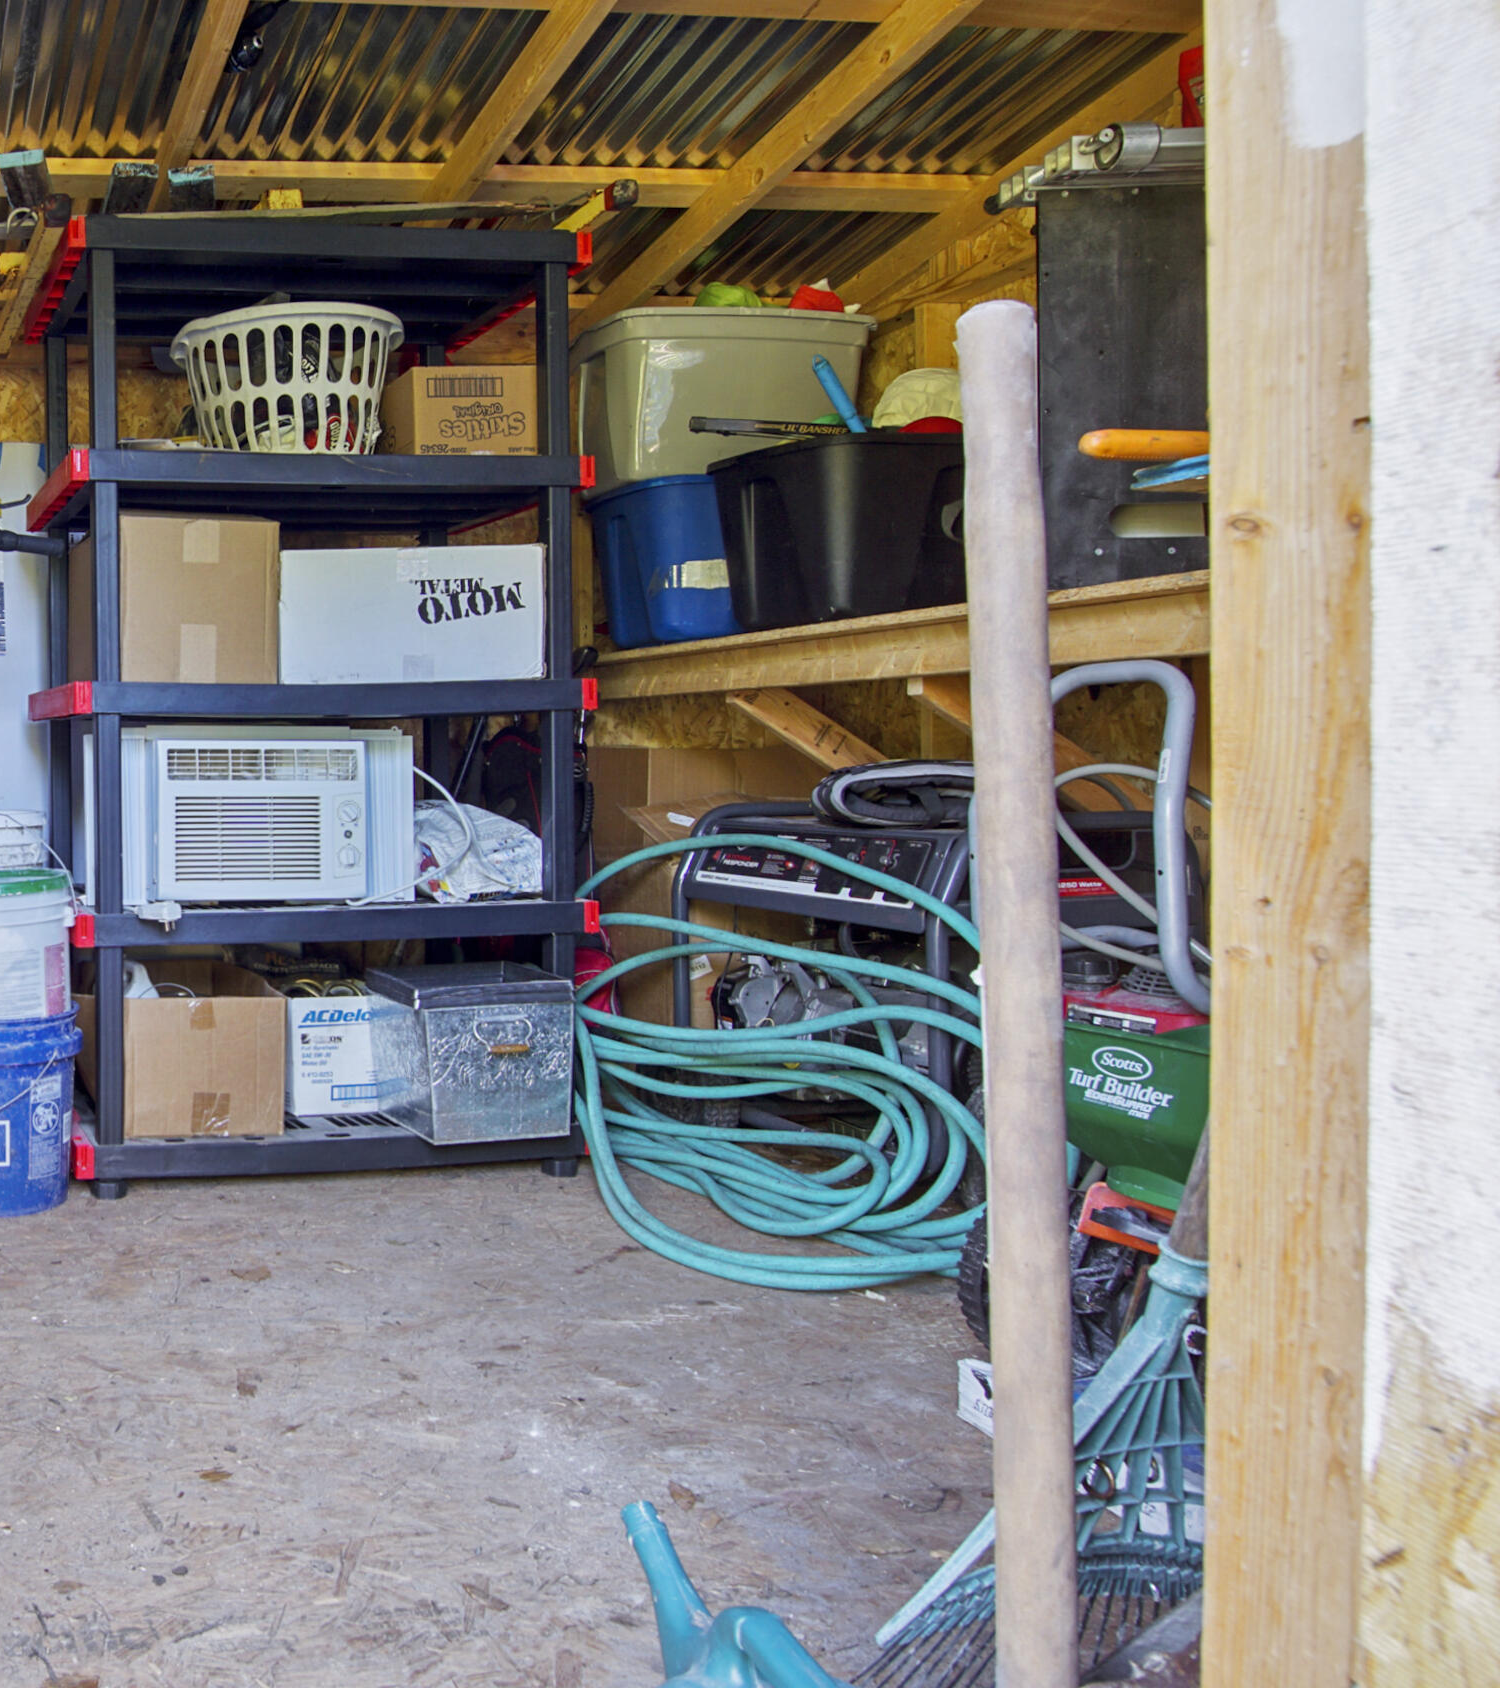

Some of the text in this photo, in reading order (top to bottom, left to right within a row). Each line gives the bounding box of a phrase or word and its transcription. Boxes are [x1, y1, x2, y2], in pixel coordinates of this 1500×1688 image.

[438, 411, 526, 441] Skittles
[415, 578, 483, 595] METAL
[417, 582, 526, 624] MOTO
[1100, 1052, 1143, 1074] Scotts
[1069, 1067, 1104, 1090] Turf
[1103, 1077, 1174, 1108] Builder
